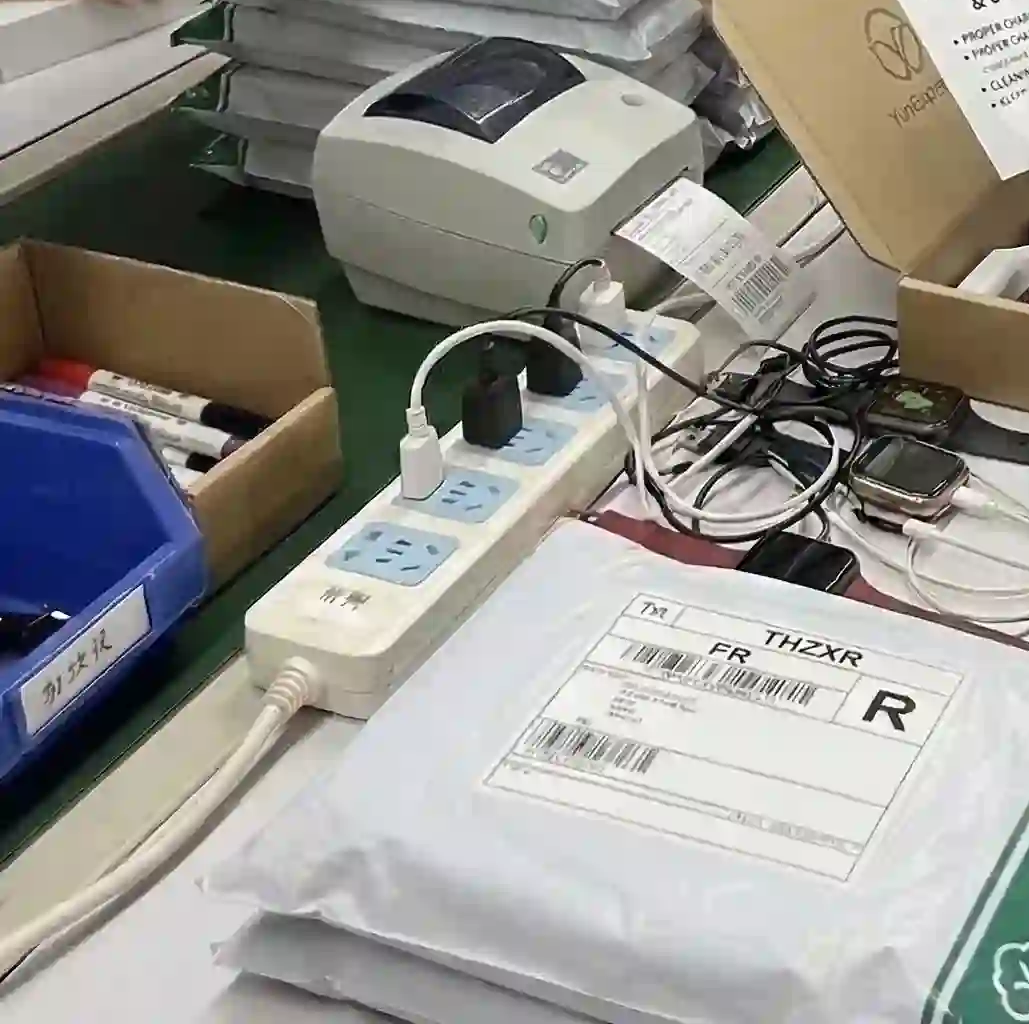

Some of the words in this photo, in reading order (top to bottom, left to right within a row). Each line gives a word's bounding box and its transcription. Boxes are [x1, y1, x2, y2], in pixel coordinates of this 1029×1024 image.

[708, 641, 752, 664] FR
[764, 629, 864, 668] THZXR
[861, 688, 916, 732] R
